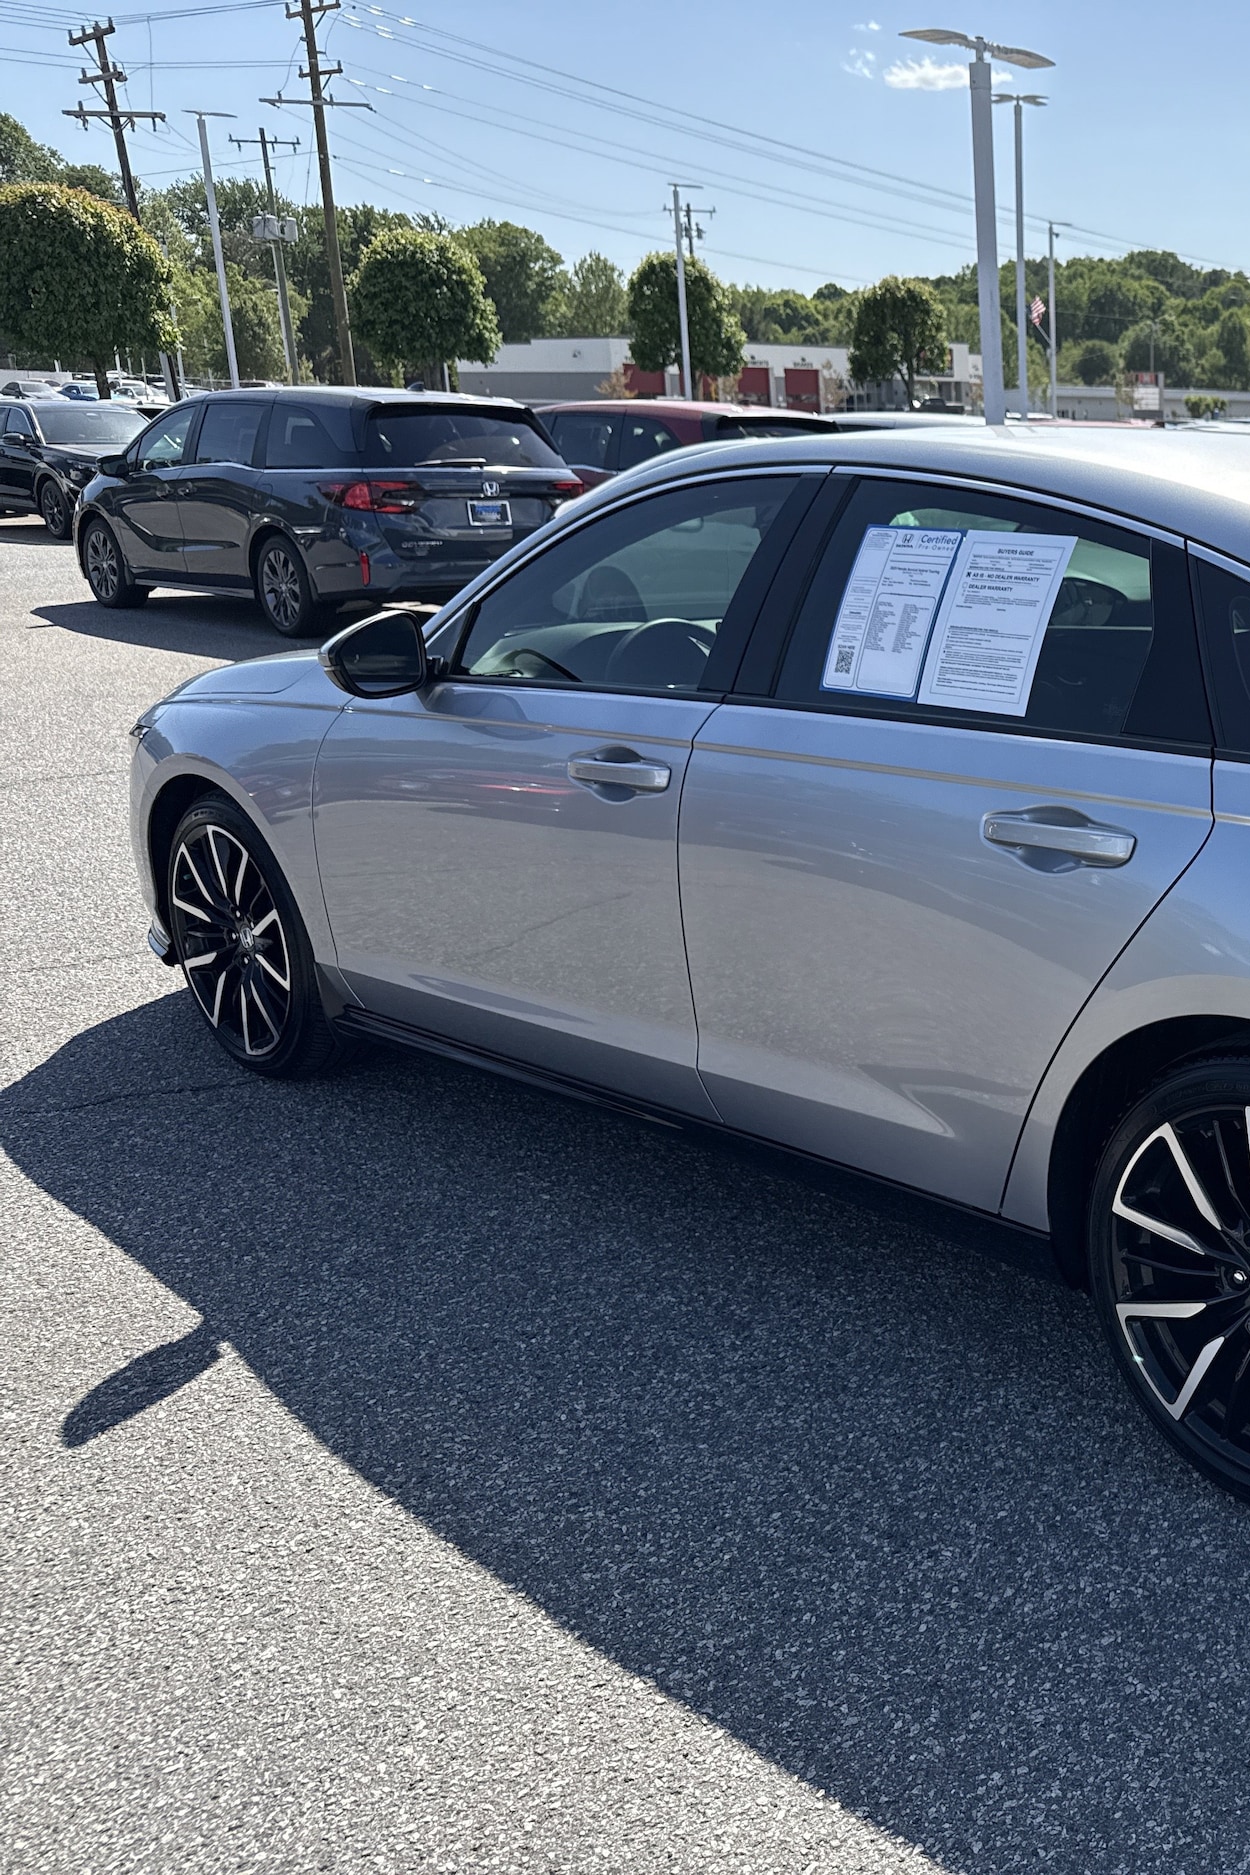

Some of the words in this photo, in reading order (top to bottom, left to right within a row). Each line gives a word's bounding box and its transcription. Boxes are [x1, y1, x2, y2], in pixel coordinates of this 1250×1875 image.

[920, 534, 959, 545] Certified
[1013, 574, 1040, 582] WARRANTY
[987, 584, 1013, 592] WARRANTY
